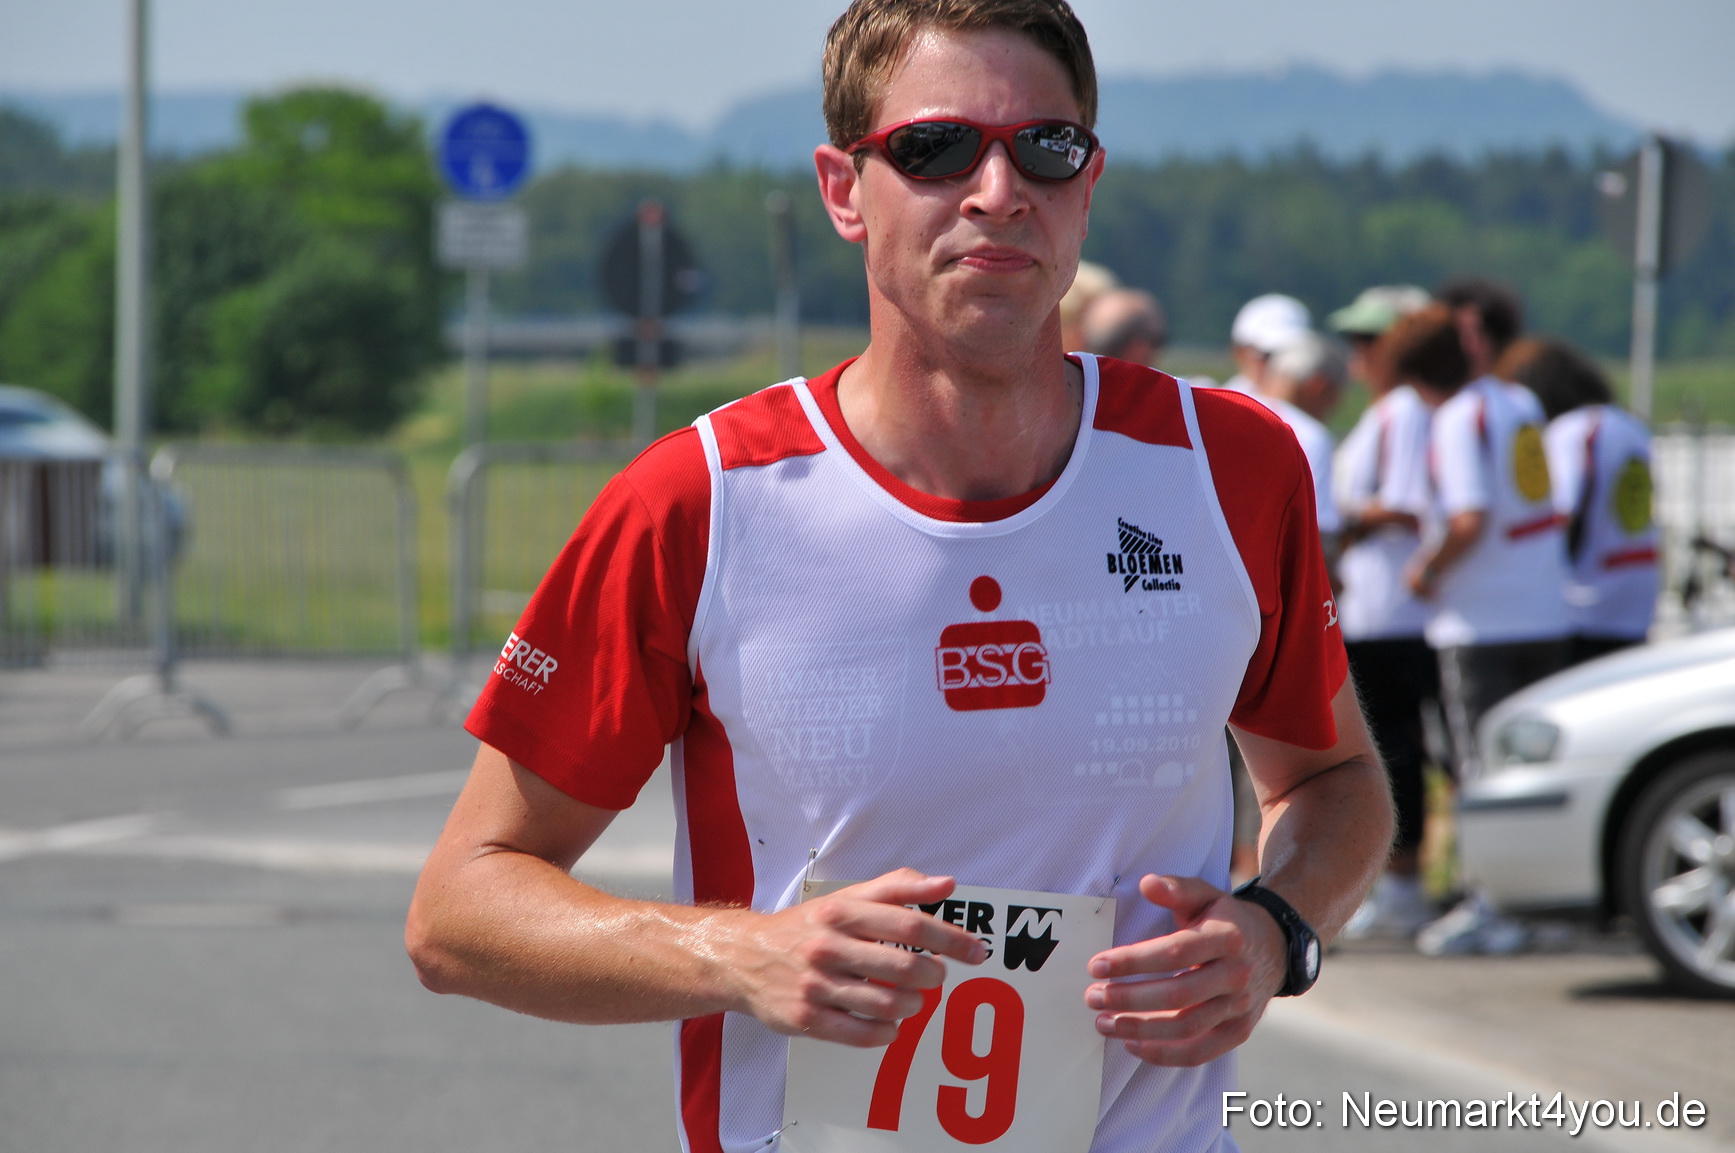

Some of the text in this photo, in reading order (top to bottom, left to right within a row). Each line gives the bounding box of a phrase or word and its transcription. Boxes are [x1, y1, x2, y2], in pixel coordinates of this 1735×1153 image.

[1107, 553, 1183, 575] BLOEMEN
[1043, 619, 1172, 649] ADTLAUF
[935, 641, 1051, 692] BSG
[770, 722, 876, 761] NEU
[866, 976, 1025, 1145] 79
